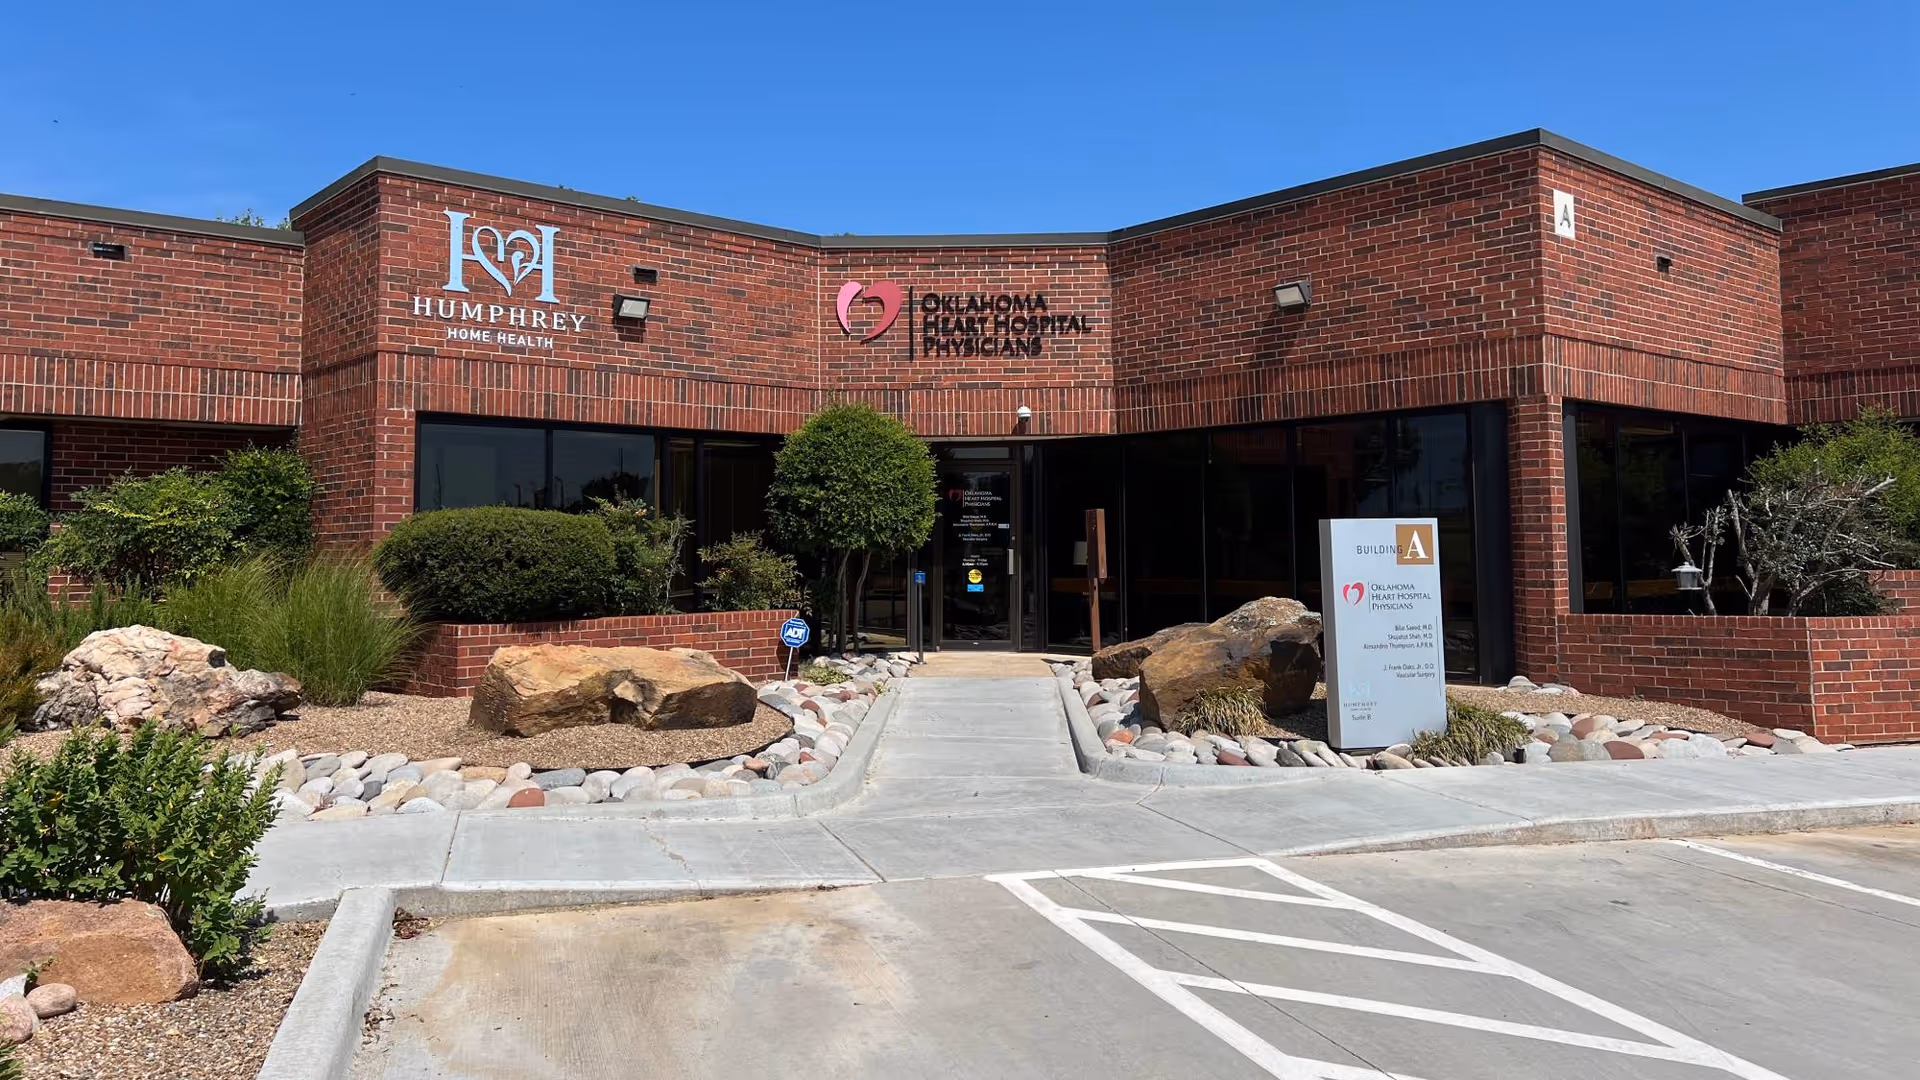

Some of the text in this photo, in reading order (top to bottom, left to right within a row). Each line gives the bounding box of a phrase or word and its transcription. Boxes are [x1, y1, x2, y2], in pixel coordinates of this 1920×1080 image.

[1560, 204, 1571, 228] A
[921, 293, 1047, 314] OKLAHOMA
[412, 296, 586, 333] HUMPHREY
[922, 314, 1092, 336] HEART HOSPITAL
[447, 327, 553, 348] HOME HEALTH
[923, 336, 1042, 357] PHYSICIANS
[1356, 529, 1429, 559] BUILDING A
[1371, 583, 1415, 591] OKLAHOMA
[1371, 592, 1431, 601] HEART HOSPITAL
[1372, 602, 1414, 611] PHYSICIANS
[786, 627, 804, 639] ADT
